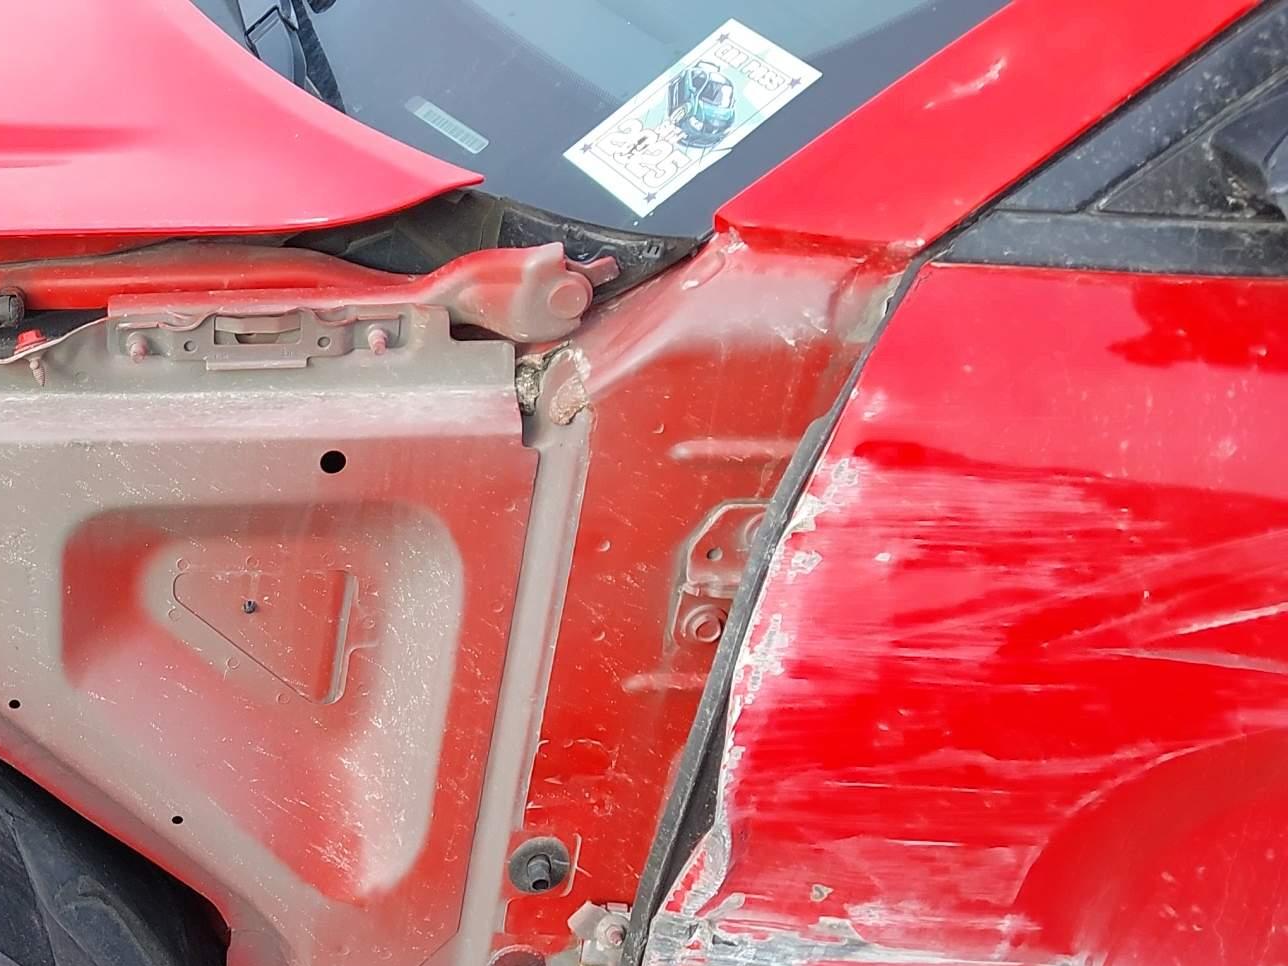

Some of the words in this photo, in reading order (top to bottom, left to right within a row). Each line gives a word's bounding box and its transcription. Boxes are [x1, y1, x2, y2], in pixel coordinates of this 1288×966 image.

[713, 43, 748, 69] CAR
[740, 57, 789, 92] PASS
[595, 118, 692, 189] 2025
